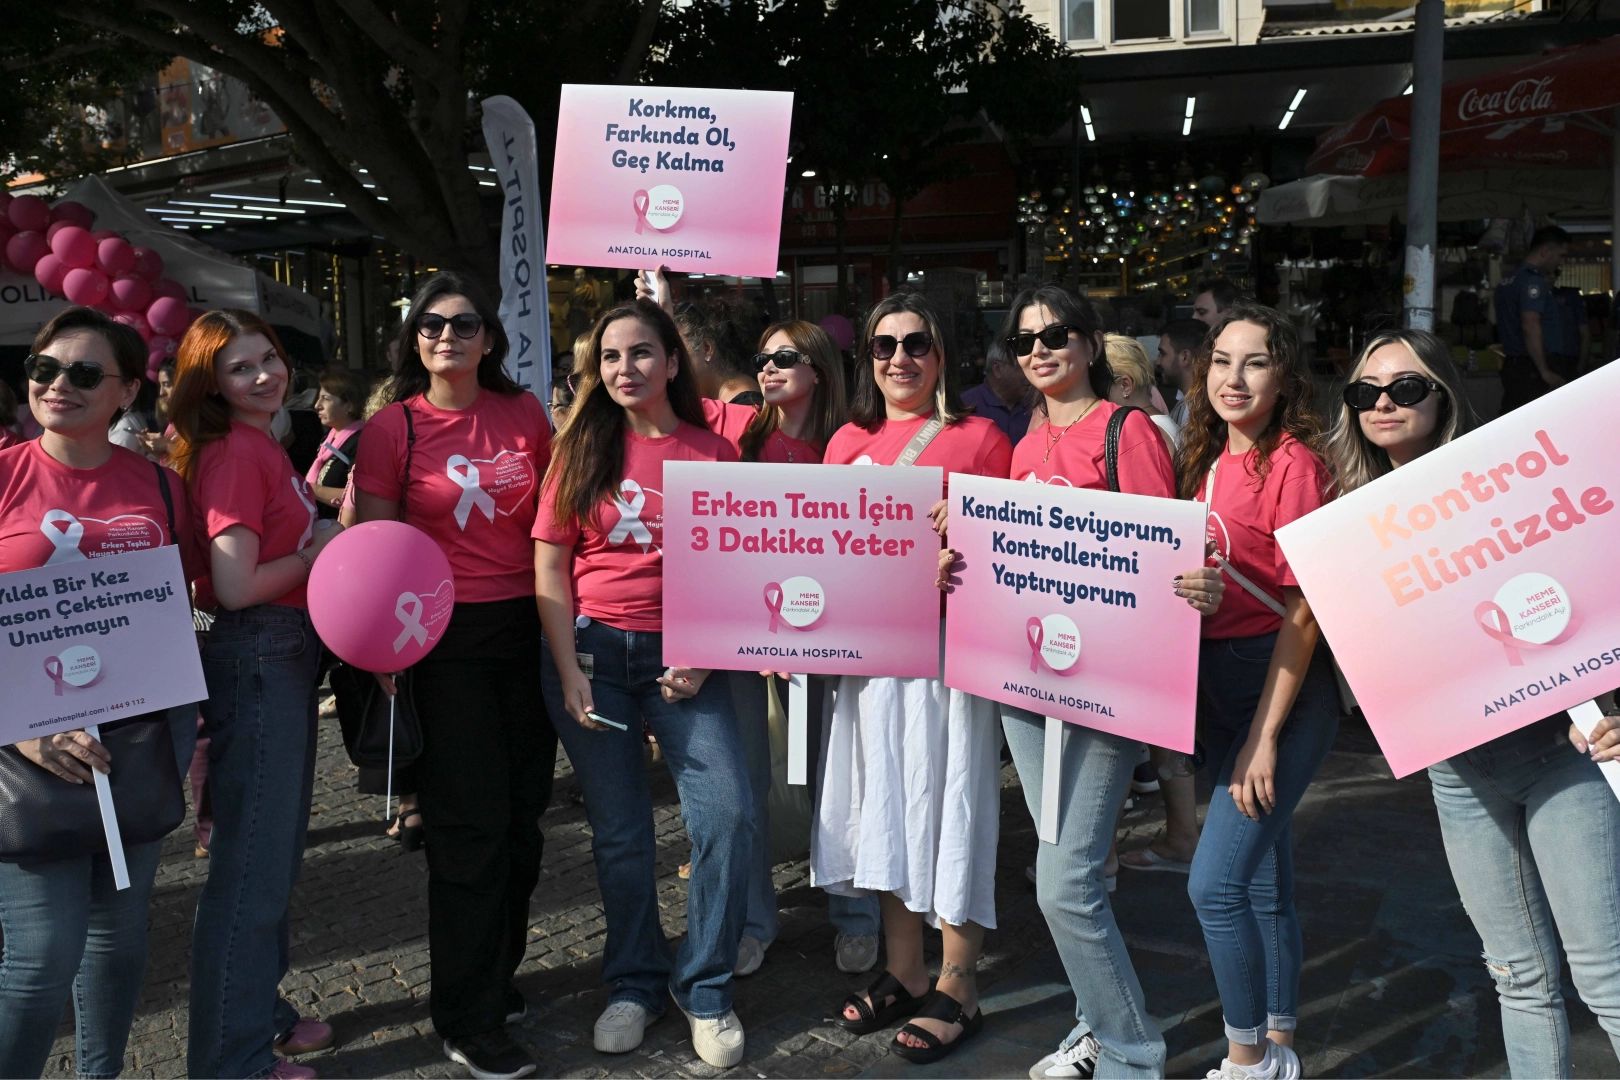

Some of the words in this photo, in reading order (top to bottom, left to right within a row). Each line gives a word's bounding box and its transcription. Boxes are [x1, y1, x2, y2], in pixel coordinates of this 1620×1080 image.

[628, 98, 717, 124] Korkma,
[1458, 75, 1555, 121] Coca-Cola
[605, 124, 699, 146] Farkında
[705, 127, 736, 151] Ol,
[612, 150, 650, 174] Geç
[655, 151, 724, 173] Kalma
[607, 245, 658, 257] ANATOLIA
[661, 248, 712, 260] HOSPITAL
[915, 419, 941, 446] ONNY
[1366, 429, 1570, 549] Kontrol
[691, 490, 777, 518] Erken
[785, 492, 850, 519] Tanı
[859, 487, 914, 527] İçin
[962, 495, 1043, 527] Kendimi
[1049, 506, 1182, 550] Seviyorum,
[646, 521, 663, 529] Haya
[126, 540, 151, 548] Teşhis
[690, 526, 709, 551] 3
[719, 527, 825, 554] Dakika
[832, 529, 915, 557] Yeter
[992, 531, 1140, 574] Kontrollerimi
[1381, 486, 1615, 608] Elimizde
[0, 583, 48, 605] Yılda
[52, 576, 87, 595] Bir
[91, 570, 130, 588] Kez
[56, 581, 174, 620] Çektirmeyi
[992, 562, 1137, 608] Yaptırıyorum
[1526, 586, 1556, 605] MEME
[1513, 611, 1554, 633] Farkındalık
[1519, 594, 1561, 619] KANSERİ
[8, 615, 130, 648] Unutmayın
[1050, 639, 1076, 650] KANSERİ
[1057, 633, 1076, 642] MEME
[737, 646, 799, 657] ANATOLIA
[802, 648, 863, 659] HOSPITAL
[1003, 681, 1056, 703] ANATOLIA
[1059, 694, 1115, 718] HOSPITAL
[1483, 672, 1571, 718] ANATOLIA
[29, 707, 105, 729] anatoliahospital.com
[110, 702, 125, 711] 444
[132, 698, 146, 706] 112
